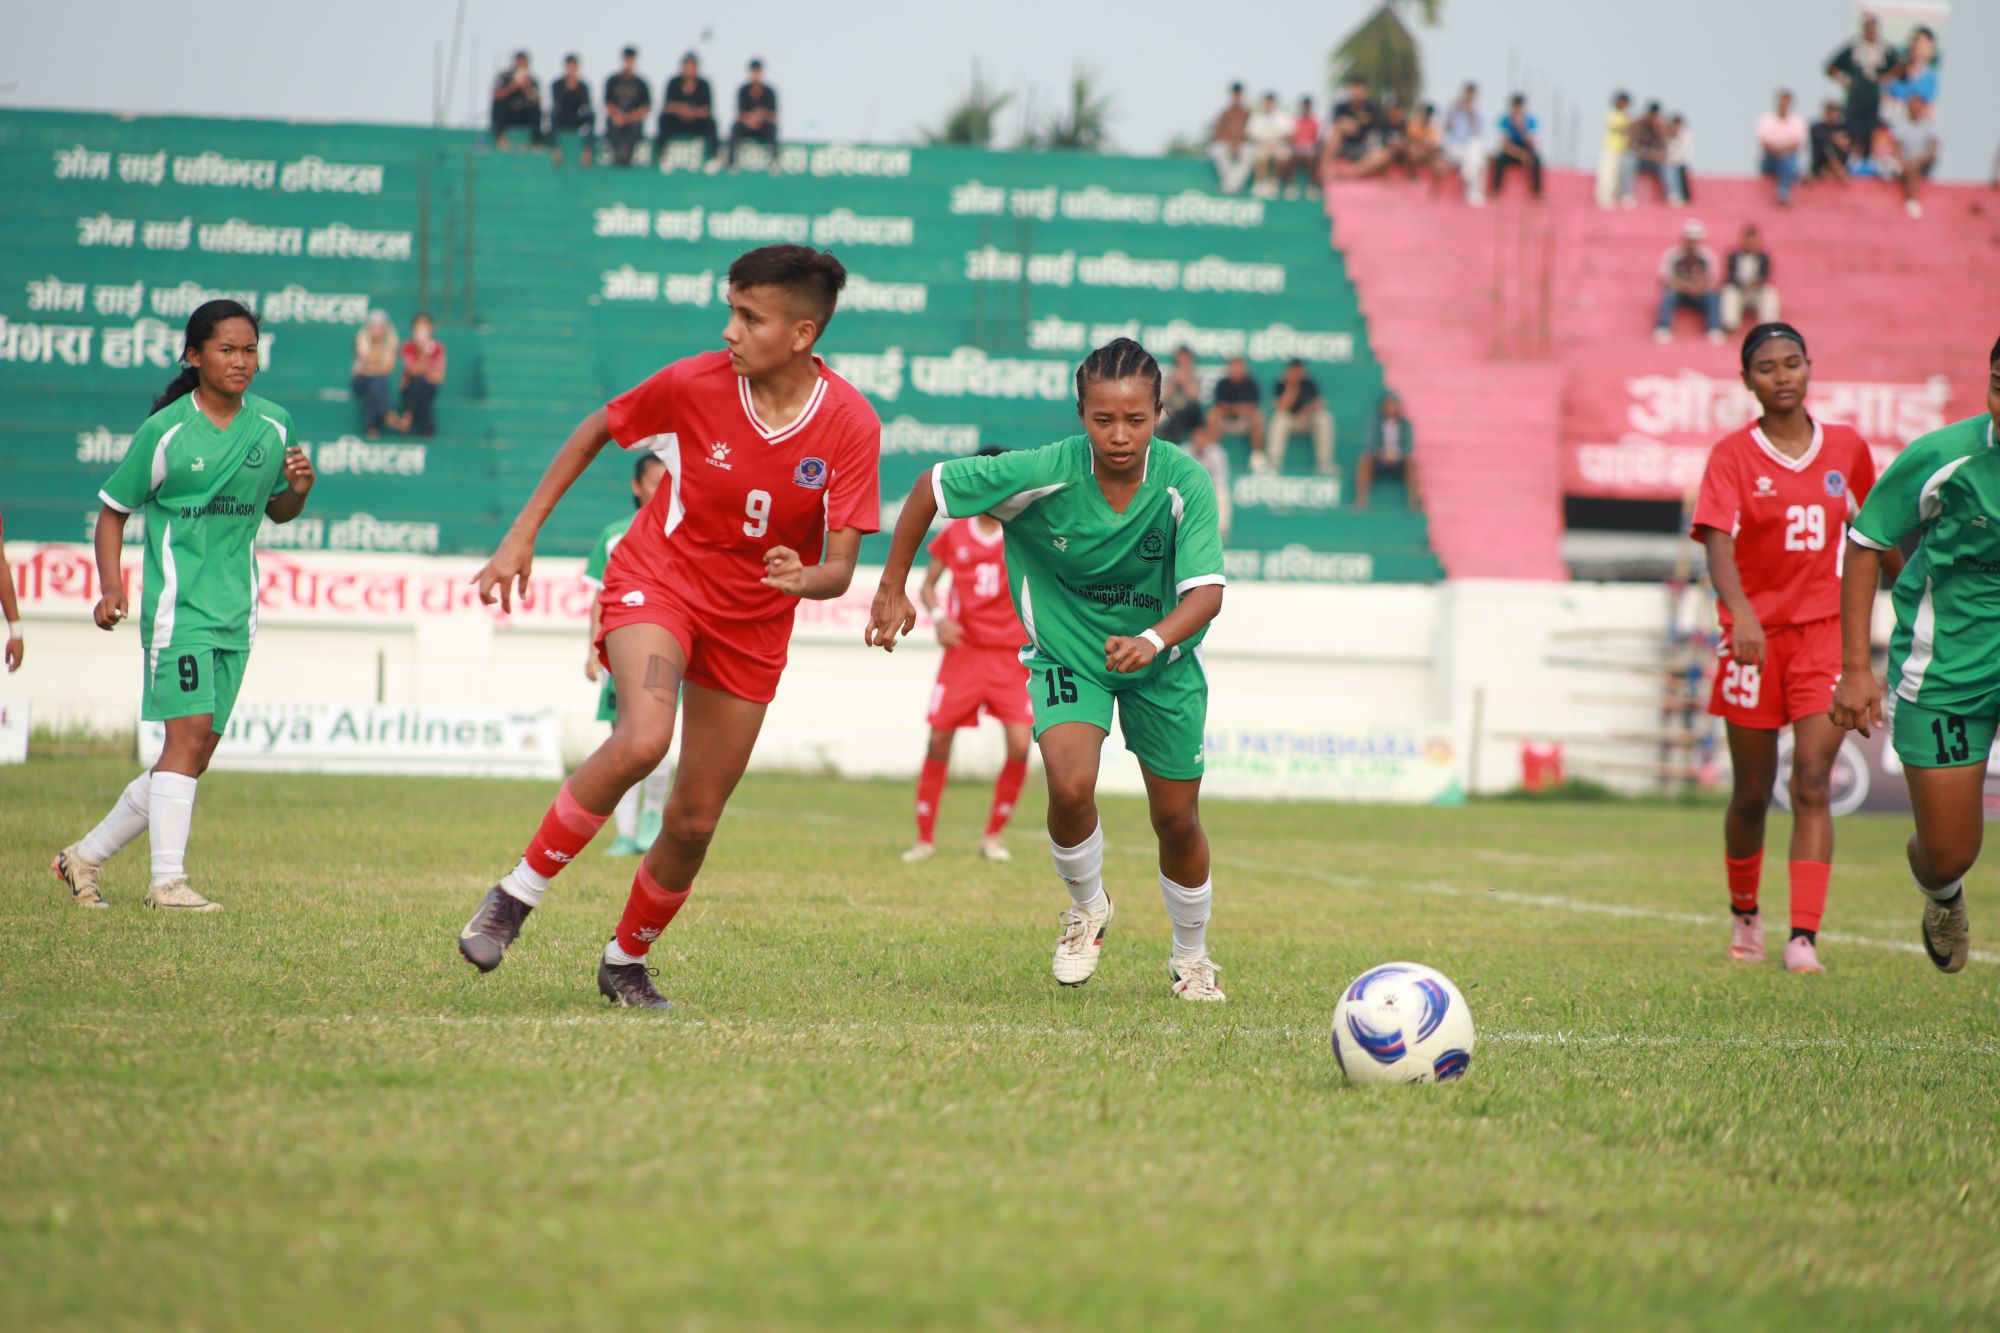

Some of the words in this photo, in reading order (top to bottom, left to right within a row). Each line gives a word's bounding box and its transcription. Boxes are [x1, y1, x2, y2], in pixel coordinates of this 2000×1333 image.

[742, 489, 772, 538] 9
[1784, 504, 1827, 551] 29
[178, 654, 199, 692] 9
[1045, 666, 1078, 708] 15
[1721, 659, 1761, 709] 29
[329, 707, 503, 748] Airlines
[1931, 715, 1970, 765] 13
